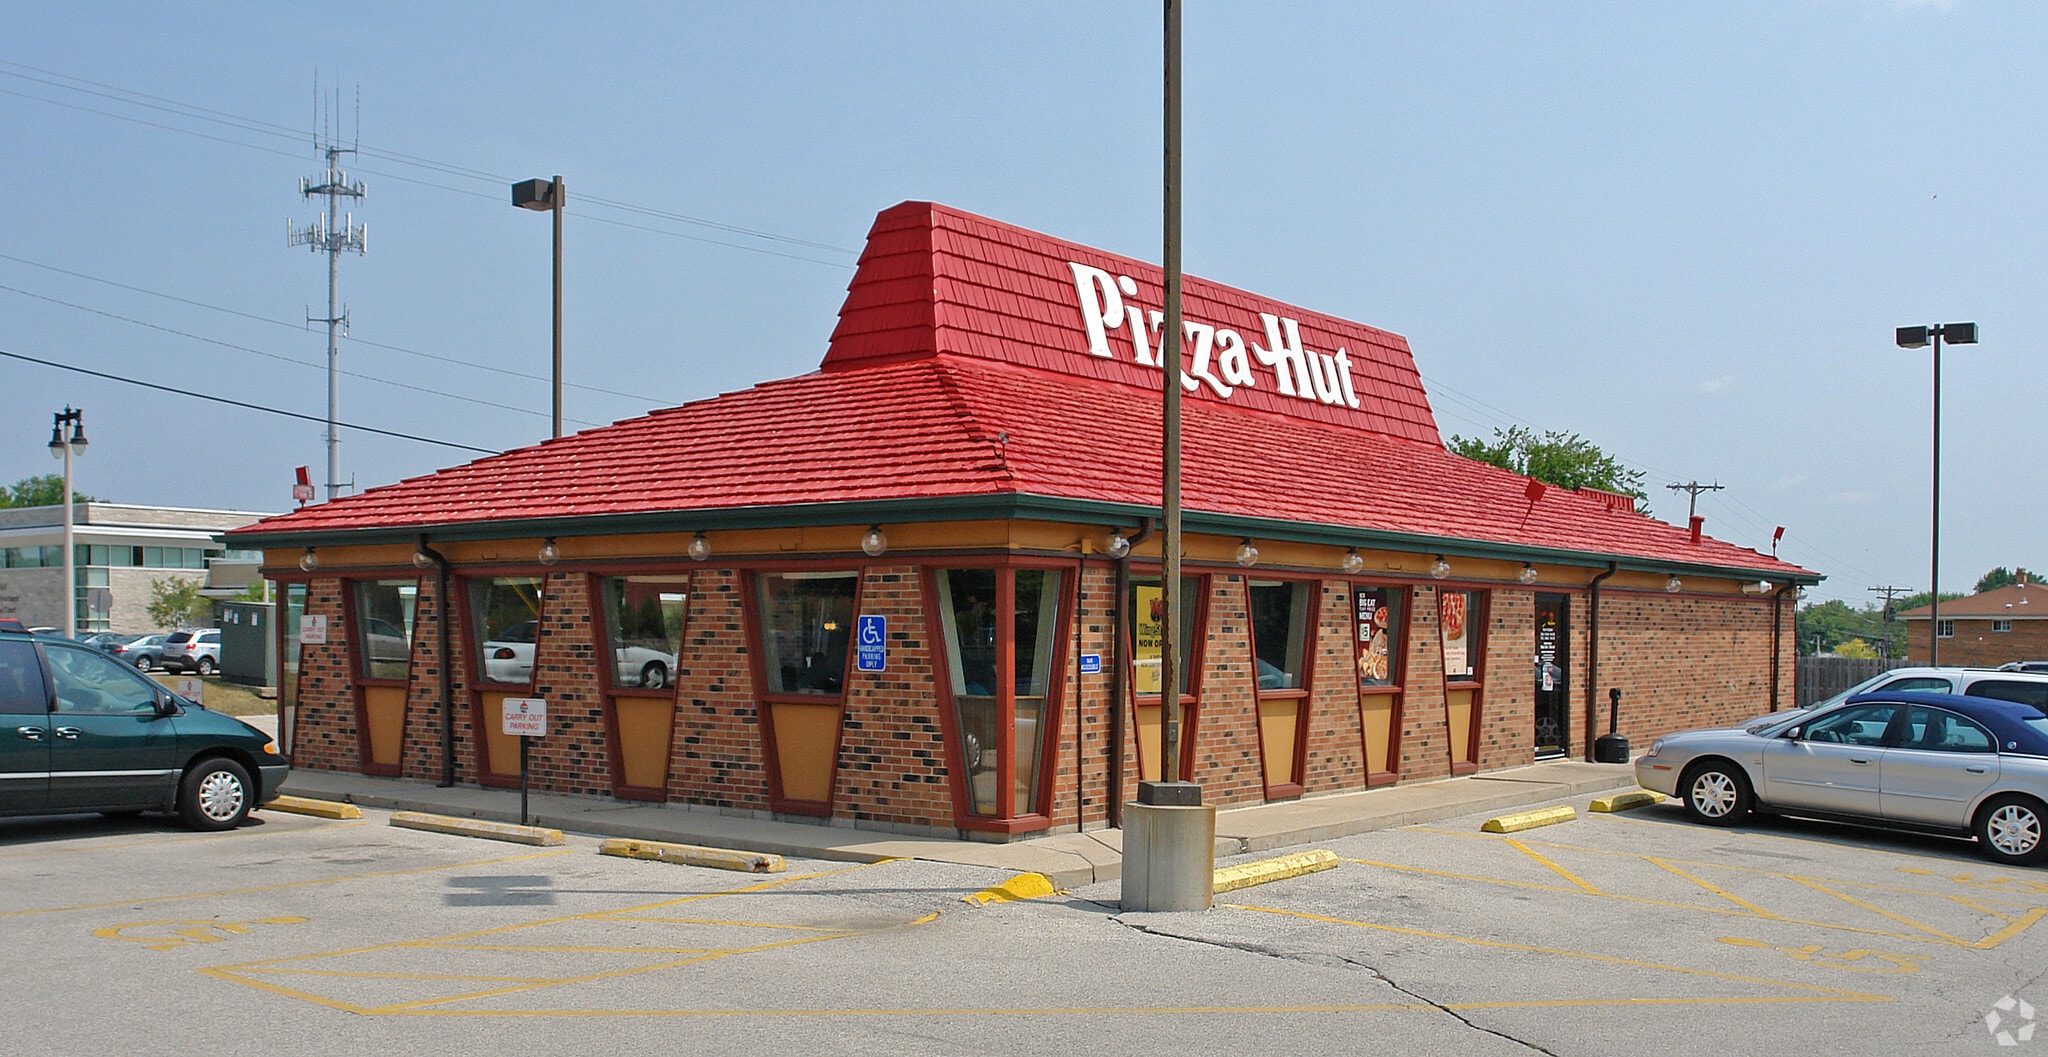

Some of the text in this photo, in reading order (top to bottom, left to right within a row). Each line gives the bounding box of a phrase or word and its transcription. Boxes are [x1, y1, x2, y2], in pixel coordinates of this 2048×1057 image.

[1068, 261, 1361, 410] Pizza Hut
[1359, 598, 1376, 607] BIG EAT
[1138, 639, 1162, 648] NOW OP
[505, 713, 543, 722] CARRY OUT
[509, 722, 539, 731] PARKING
